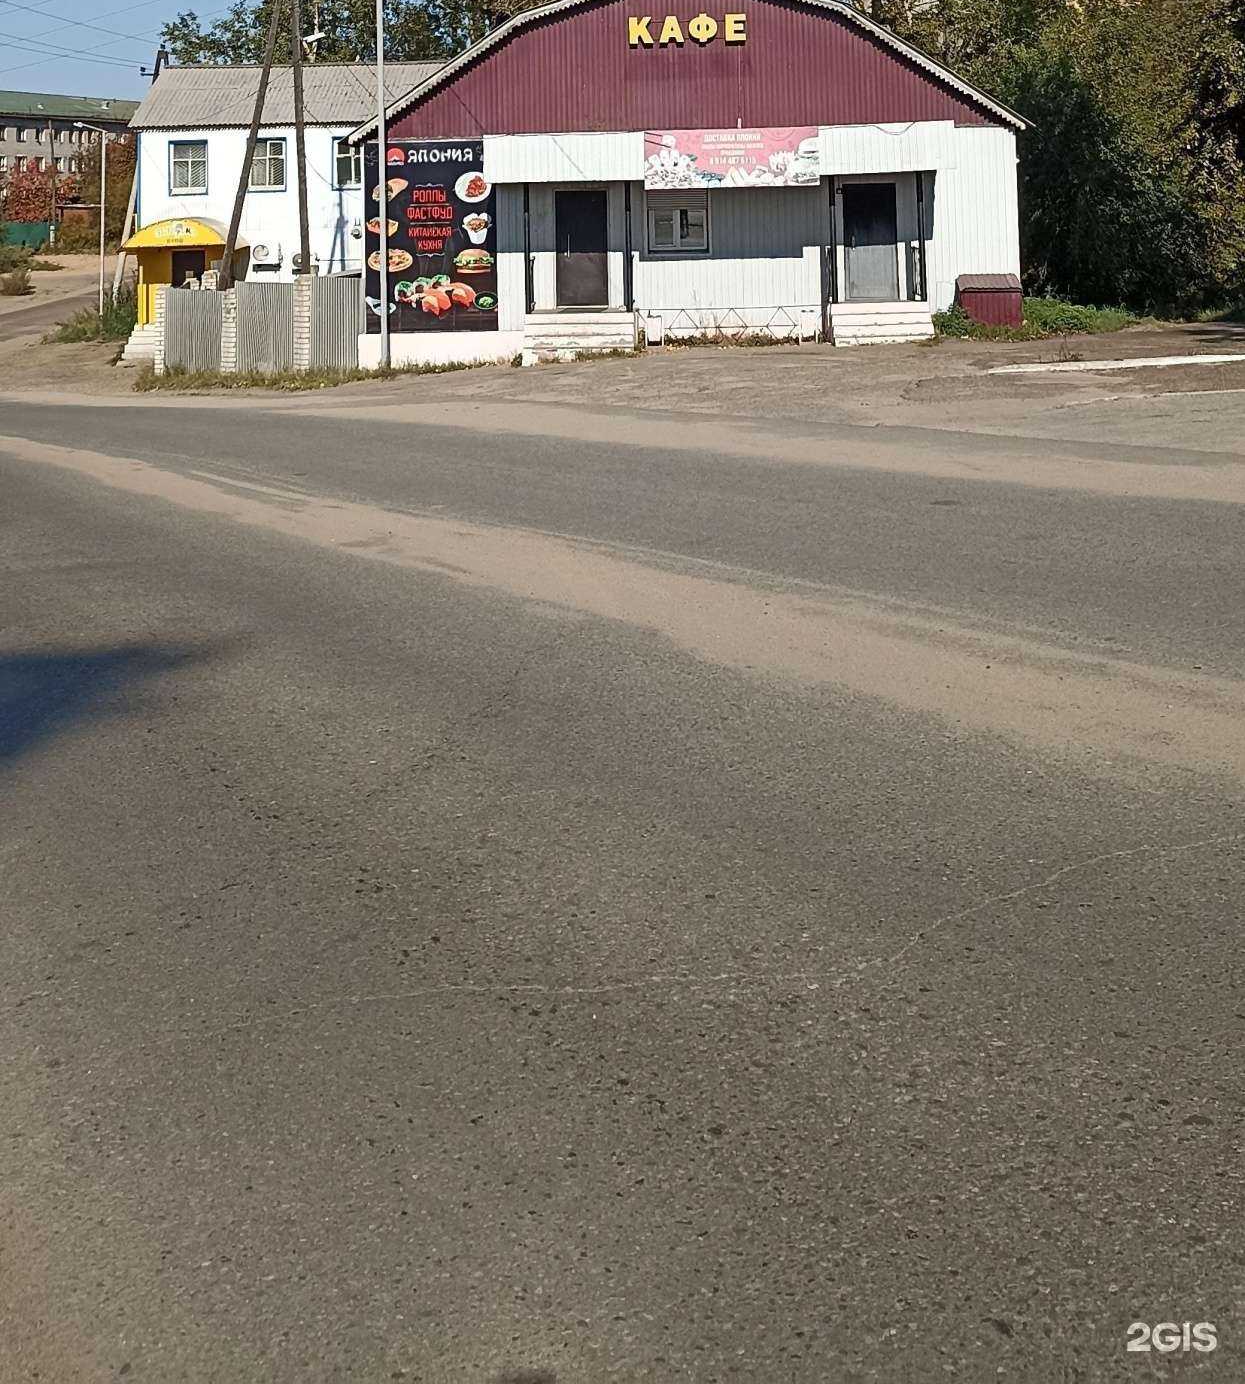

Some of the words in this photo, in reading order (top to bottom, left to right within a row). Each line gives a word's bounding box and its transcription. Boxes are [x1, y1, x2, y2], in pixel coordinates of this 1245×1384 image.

[628, 13, 747, 46] КАФЕ
[407, 148, 473, 163] ЯПОНИЯ
[413, 190, 446, 202] РОЛЛЫ
[407, 207, 453, 220] ФАСТФУД
[418, 239, 443, 250] КУХНЯ
